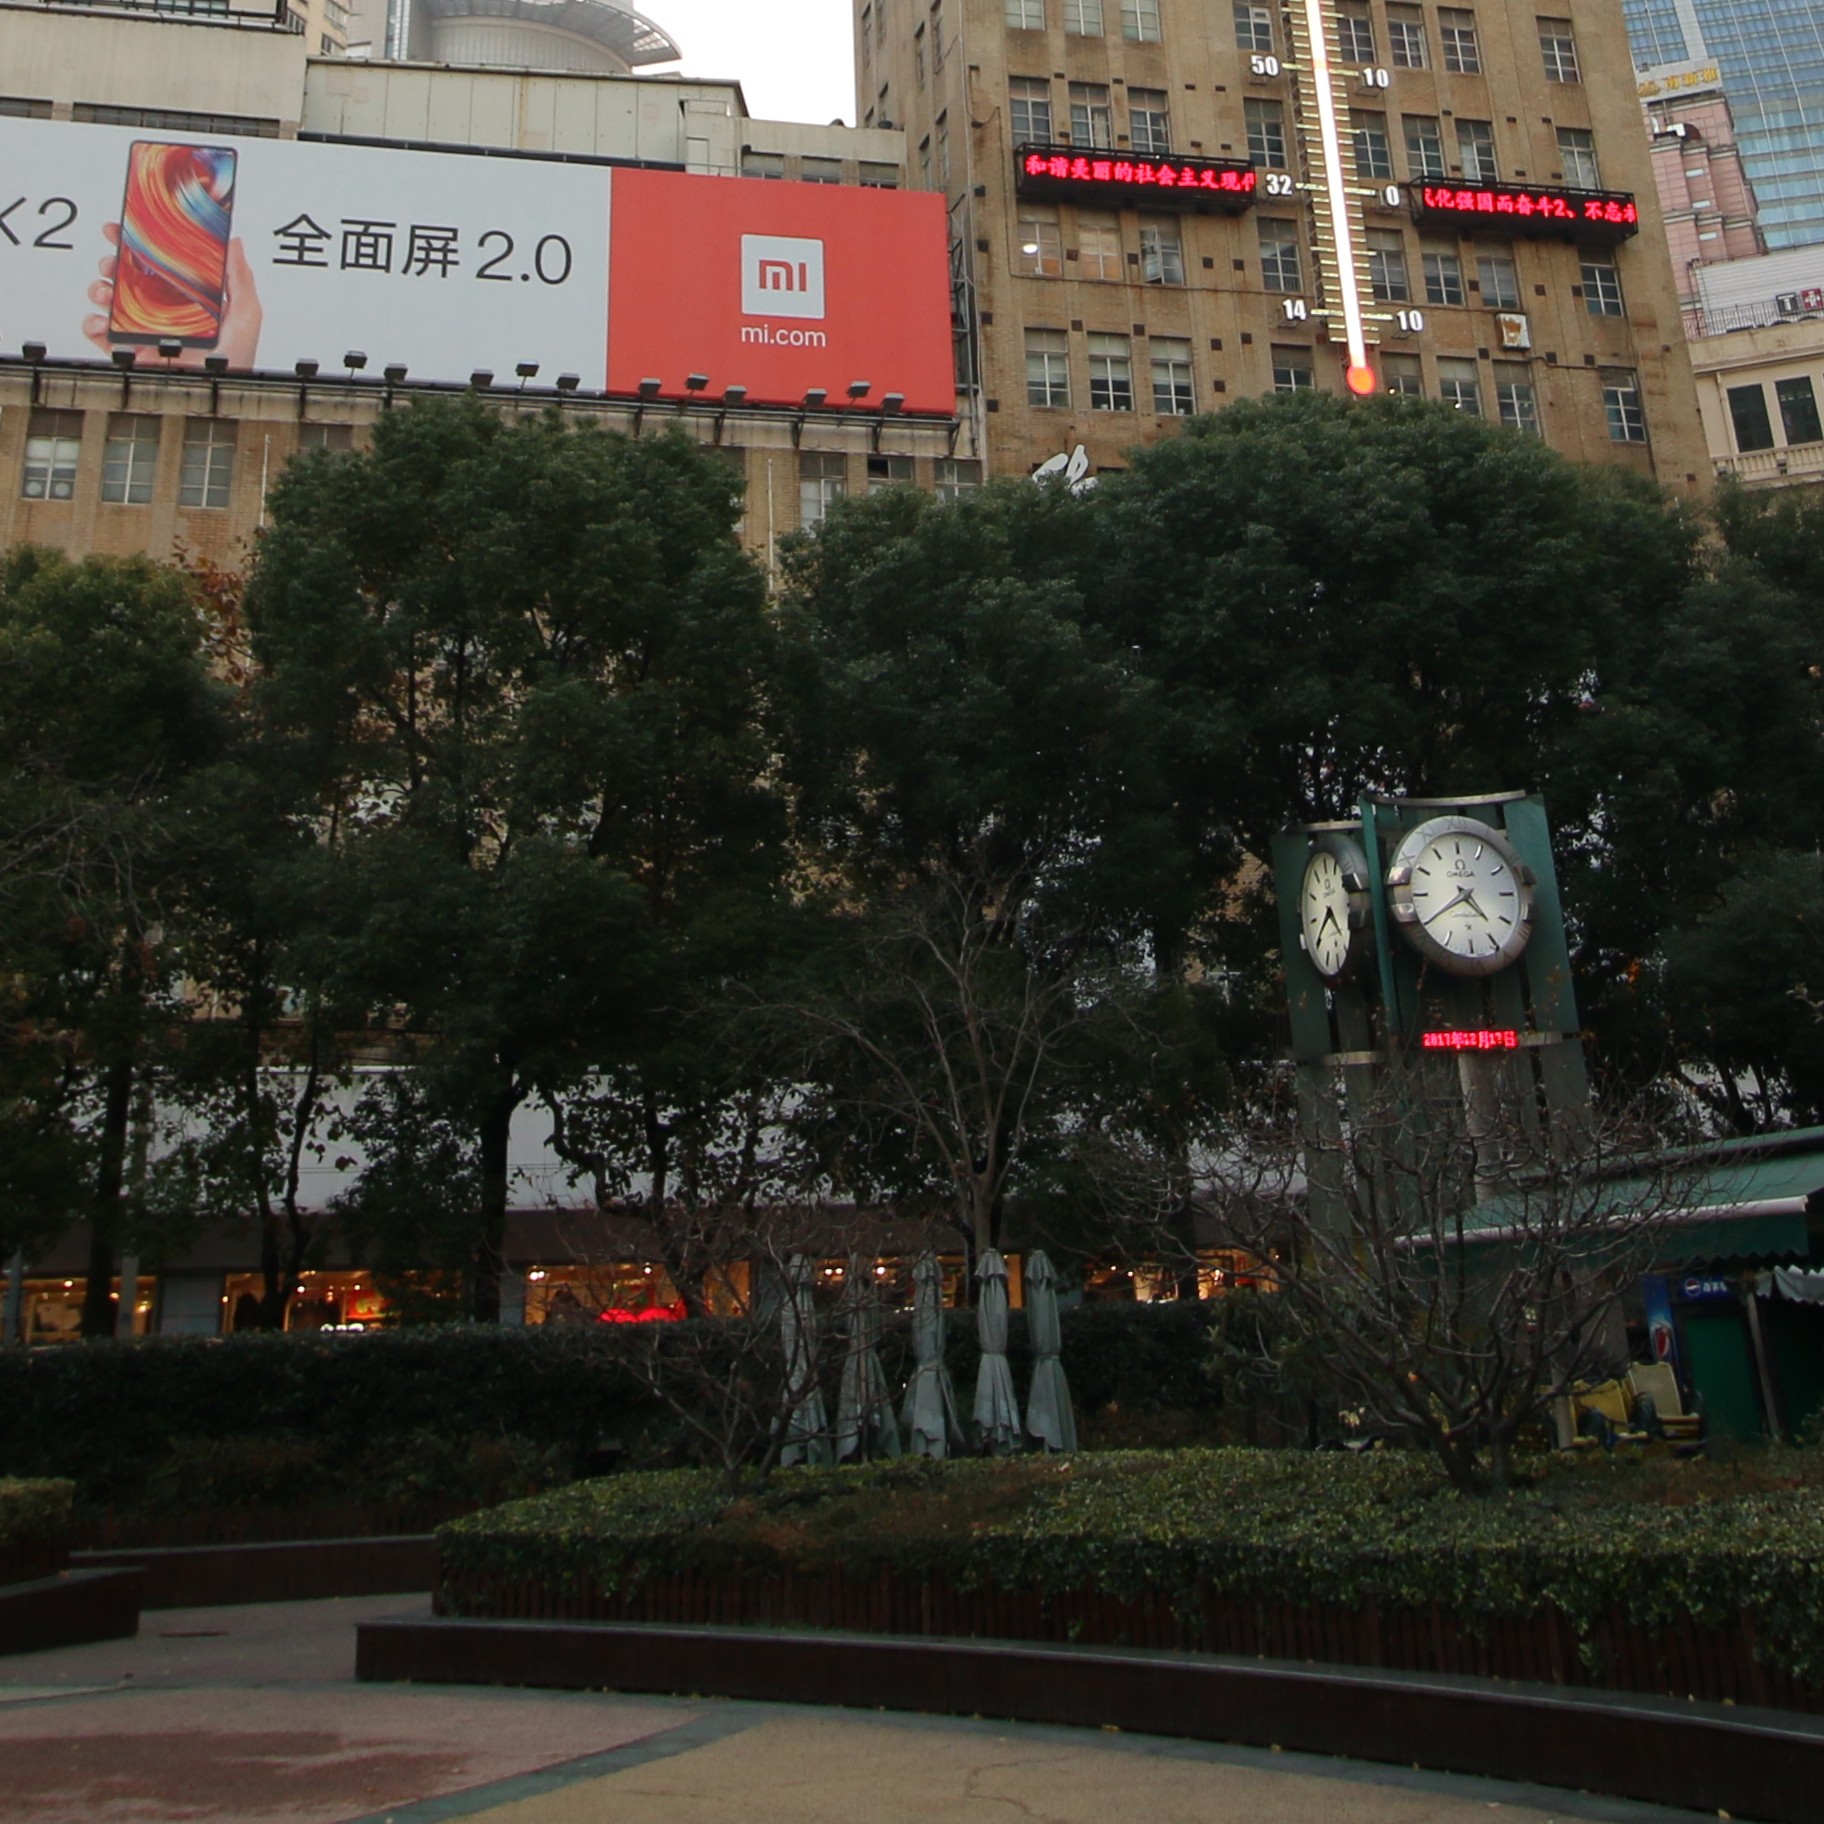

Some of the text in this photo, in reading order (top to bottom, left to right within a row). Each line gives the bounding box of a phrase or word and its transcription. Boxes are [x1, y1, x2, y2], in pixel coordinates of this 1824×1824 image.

[1251, 55, 1279, 76] 50
[1363, 67, 1390, 88] 10
[1265, 173, 1294, 196] 32
[1385, 185, 1400, 206] 0
[1283, 299, 1307, 321] 14
[1396, 310, 1424, 331] 10
[740, 322, 827, 348] mi.com
